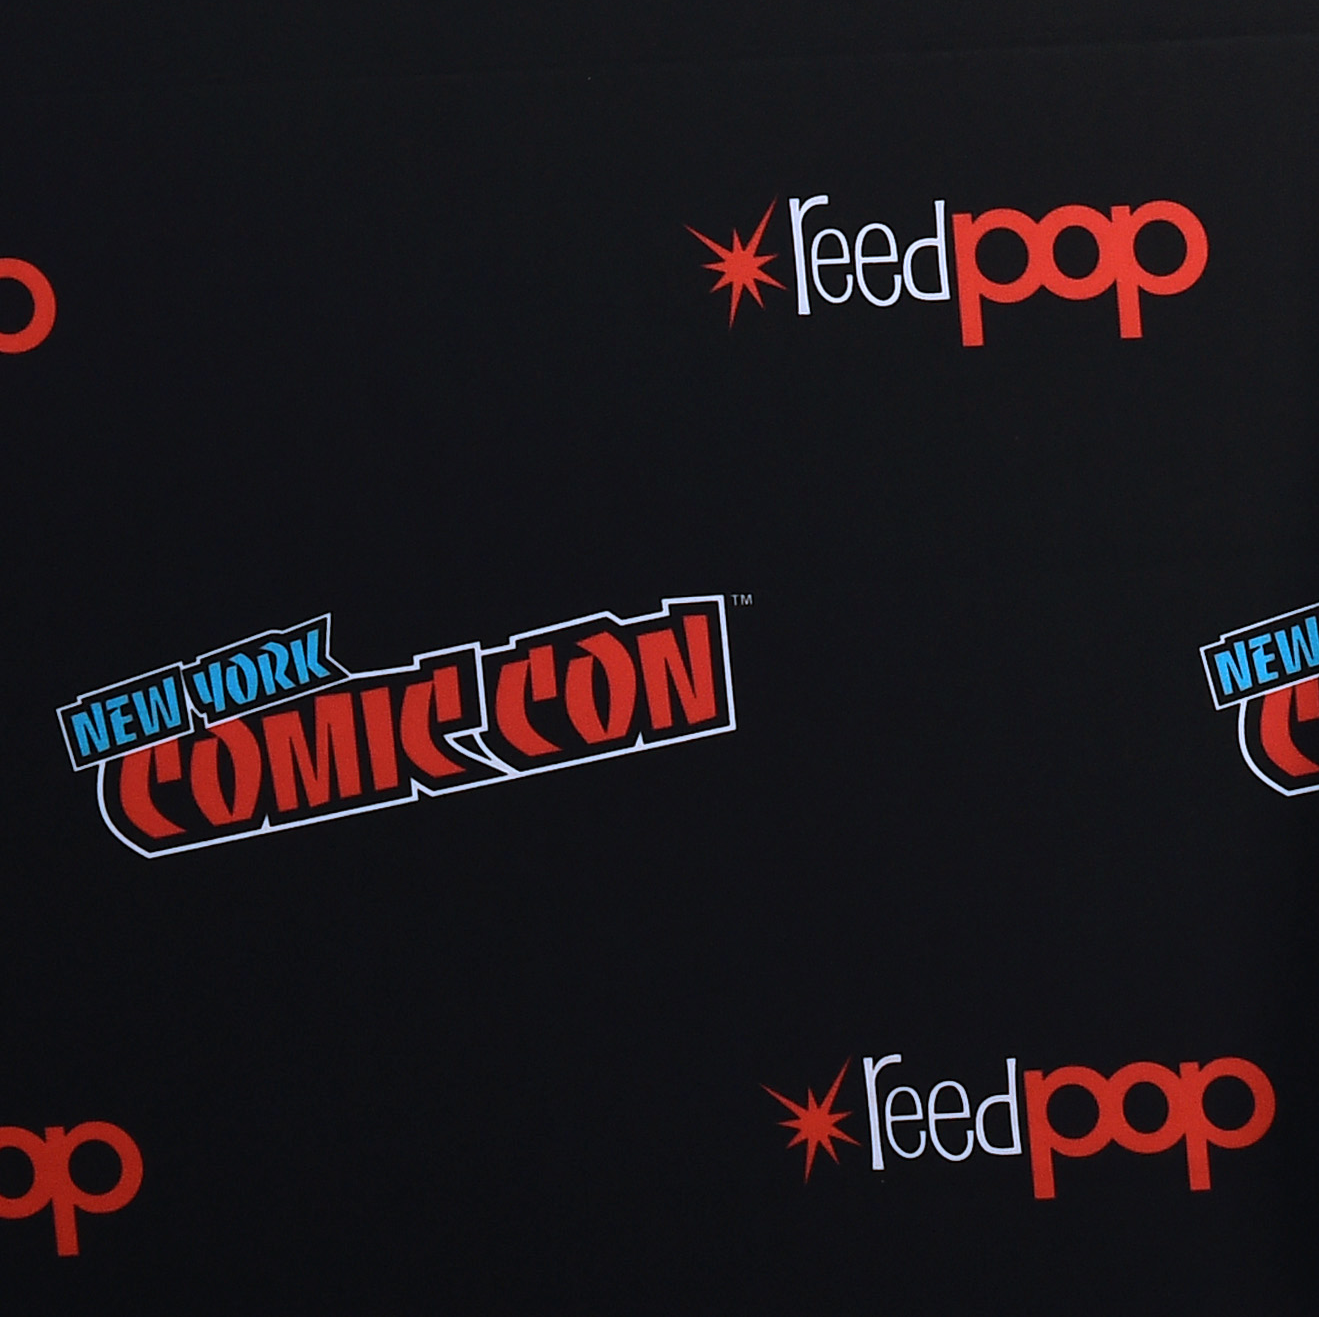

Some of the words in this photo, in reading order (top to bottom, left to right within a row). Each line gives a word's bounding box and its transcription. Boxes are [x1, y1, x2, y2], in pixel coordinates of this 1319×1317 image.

[71, 676, 182, 758] NEW
[193, 629, 331, 713] YORK
[120, 666, 466, 839] COMIC
[495, 614, 717, 757] CON
